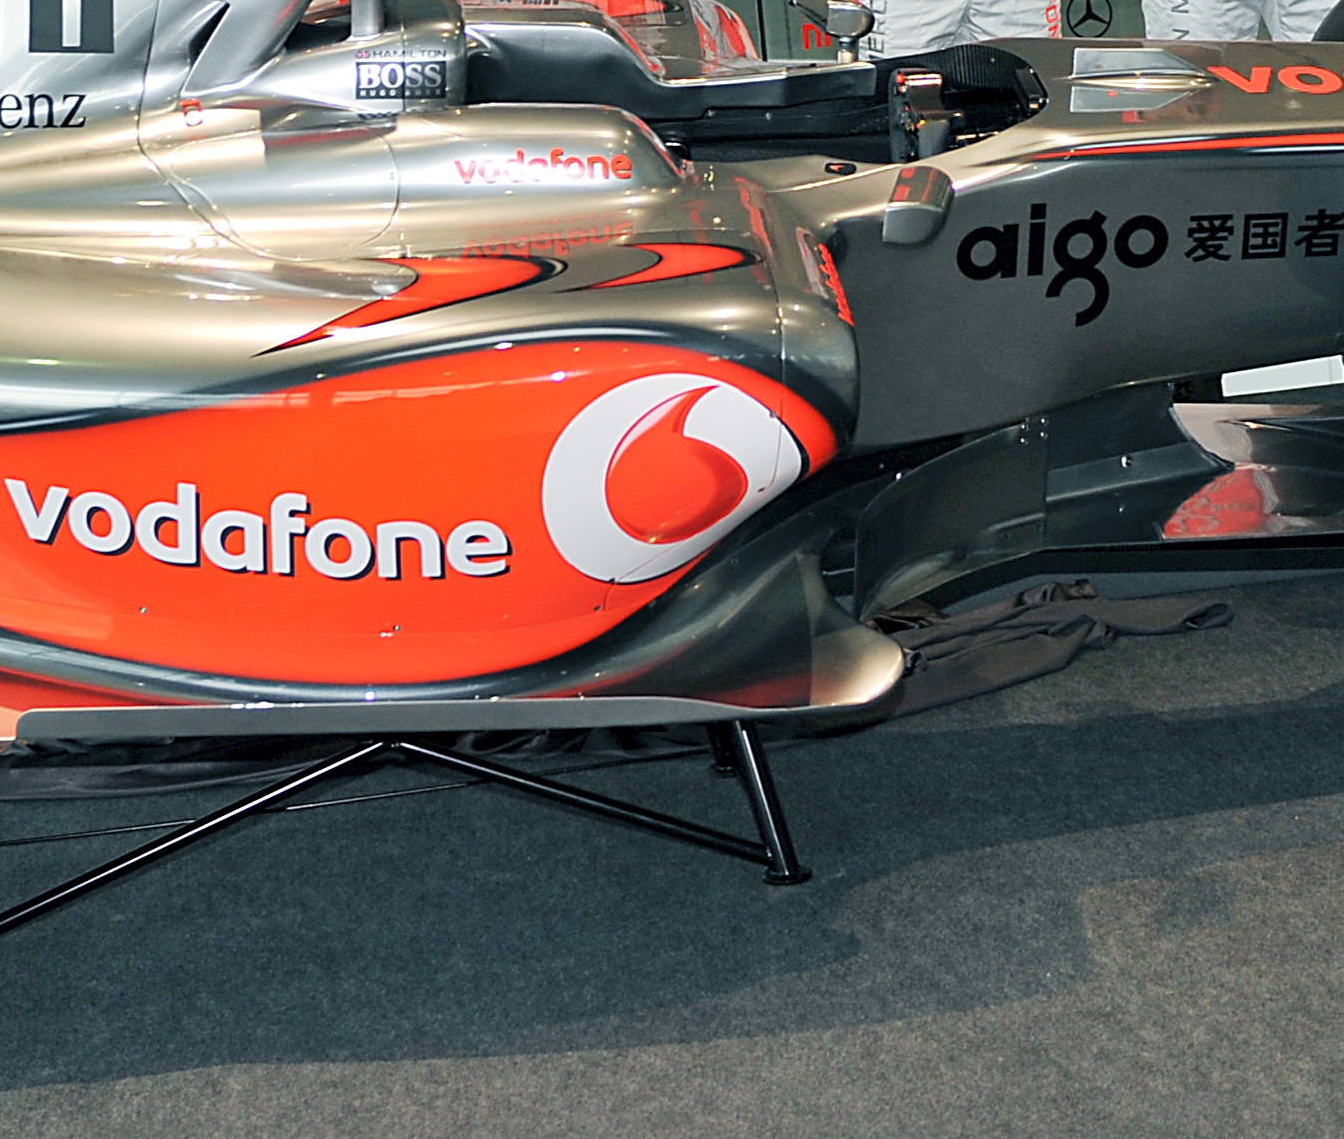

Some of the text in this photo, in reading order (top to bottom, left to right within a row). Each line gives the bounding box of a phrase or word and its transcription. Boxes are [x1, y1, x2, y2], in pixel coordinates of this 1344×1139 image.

[373, 49, 447, 58] HAMILTON
[358, 63, 442, 89] BOSS
[455, 148, 633, 185] vodafone
[957, 203, 1168, 327] aigo
[4, 478, 511, 581] vodafone
